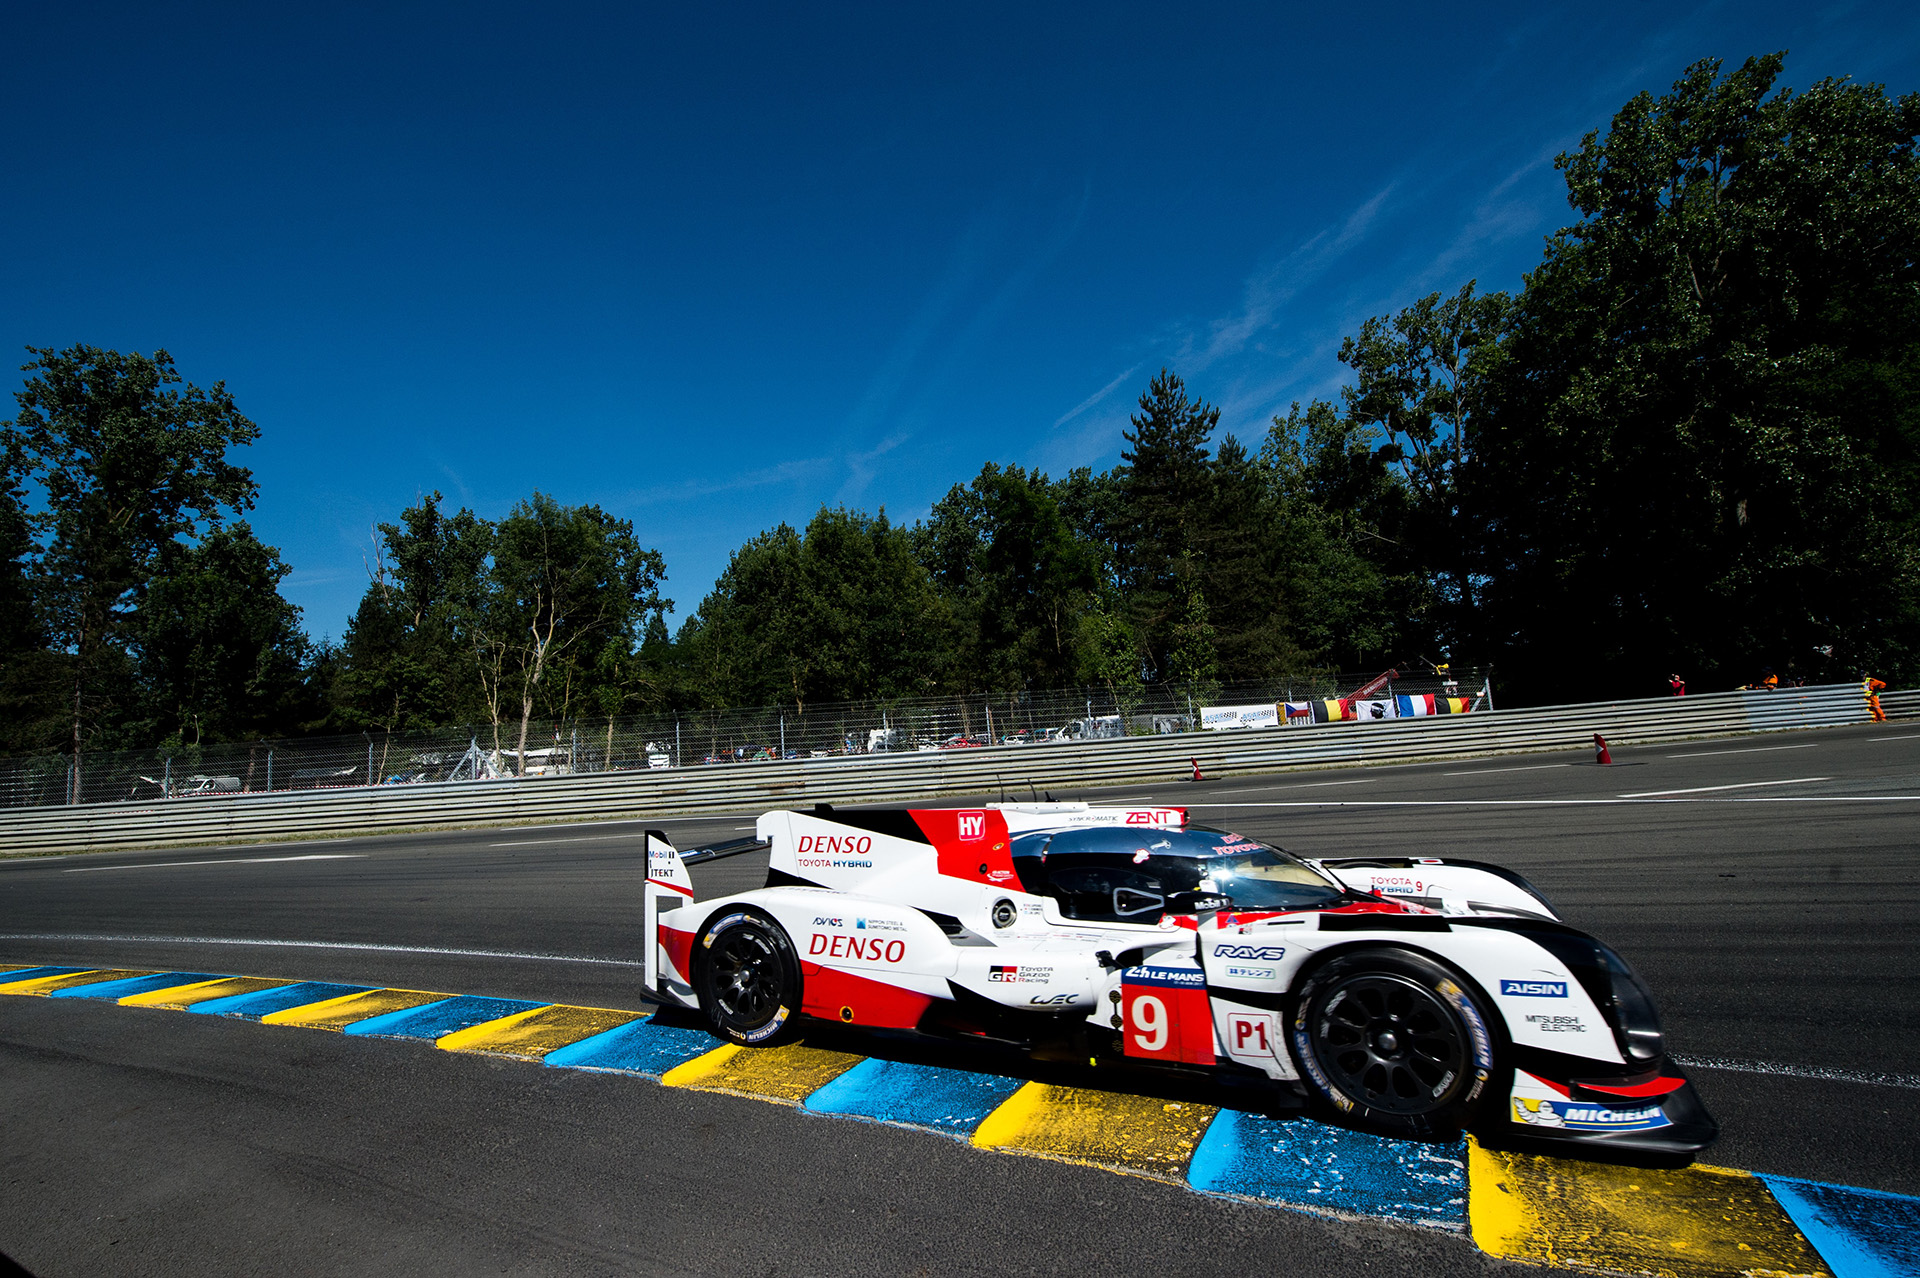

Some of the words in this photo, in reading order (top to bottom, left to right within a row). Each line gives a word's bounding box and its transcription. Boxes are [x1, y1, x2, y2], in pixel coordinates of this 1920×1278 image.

[1126, 811, 1171, 824] ZENT
[960, 816, 983, 836] HY
[798, 836, 872, 854] DENSO
[649, 850, 668, 858] Mobil
[798, 859, 831, 867] TOYOTA
[833, 860, 872, 868] HYBRID
[651, 869, 674, 877] JTEKT
[1371, 876, 1413, 886] TOYOTA
[1415, 880, 1423, 892] 9
[1194, 897, 1220, 910] Mobil
[808, 933, 906, 963] DENSO
[1214, 944, 1286, 961] RAYS
[989, 972, 1017, 983] GR
[1150, 971, 1168, 980] LE
[1167, 974, 1205, 982] MANS
[1505, 983, 1564, 995] AISIN
[1029, 993, 1080, 1005] WEC
[1131, 995, 1169, 1051] 9
[1525, 1014, 1580, 1024] MITSUBISHI
[1540, 1023, 1588, 1033] ELECTRIC
[1235, 1020, 1267, 1050] P1
[1564, 1107, 1662, 1122] MICHELIN
